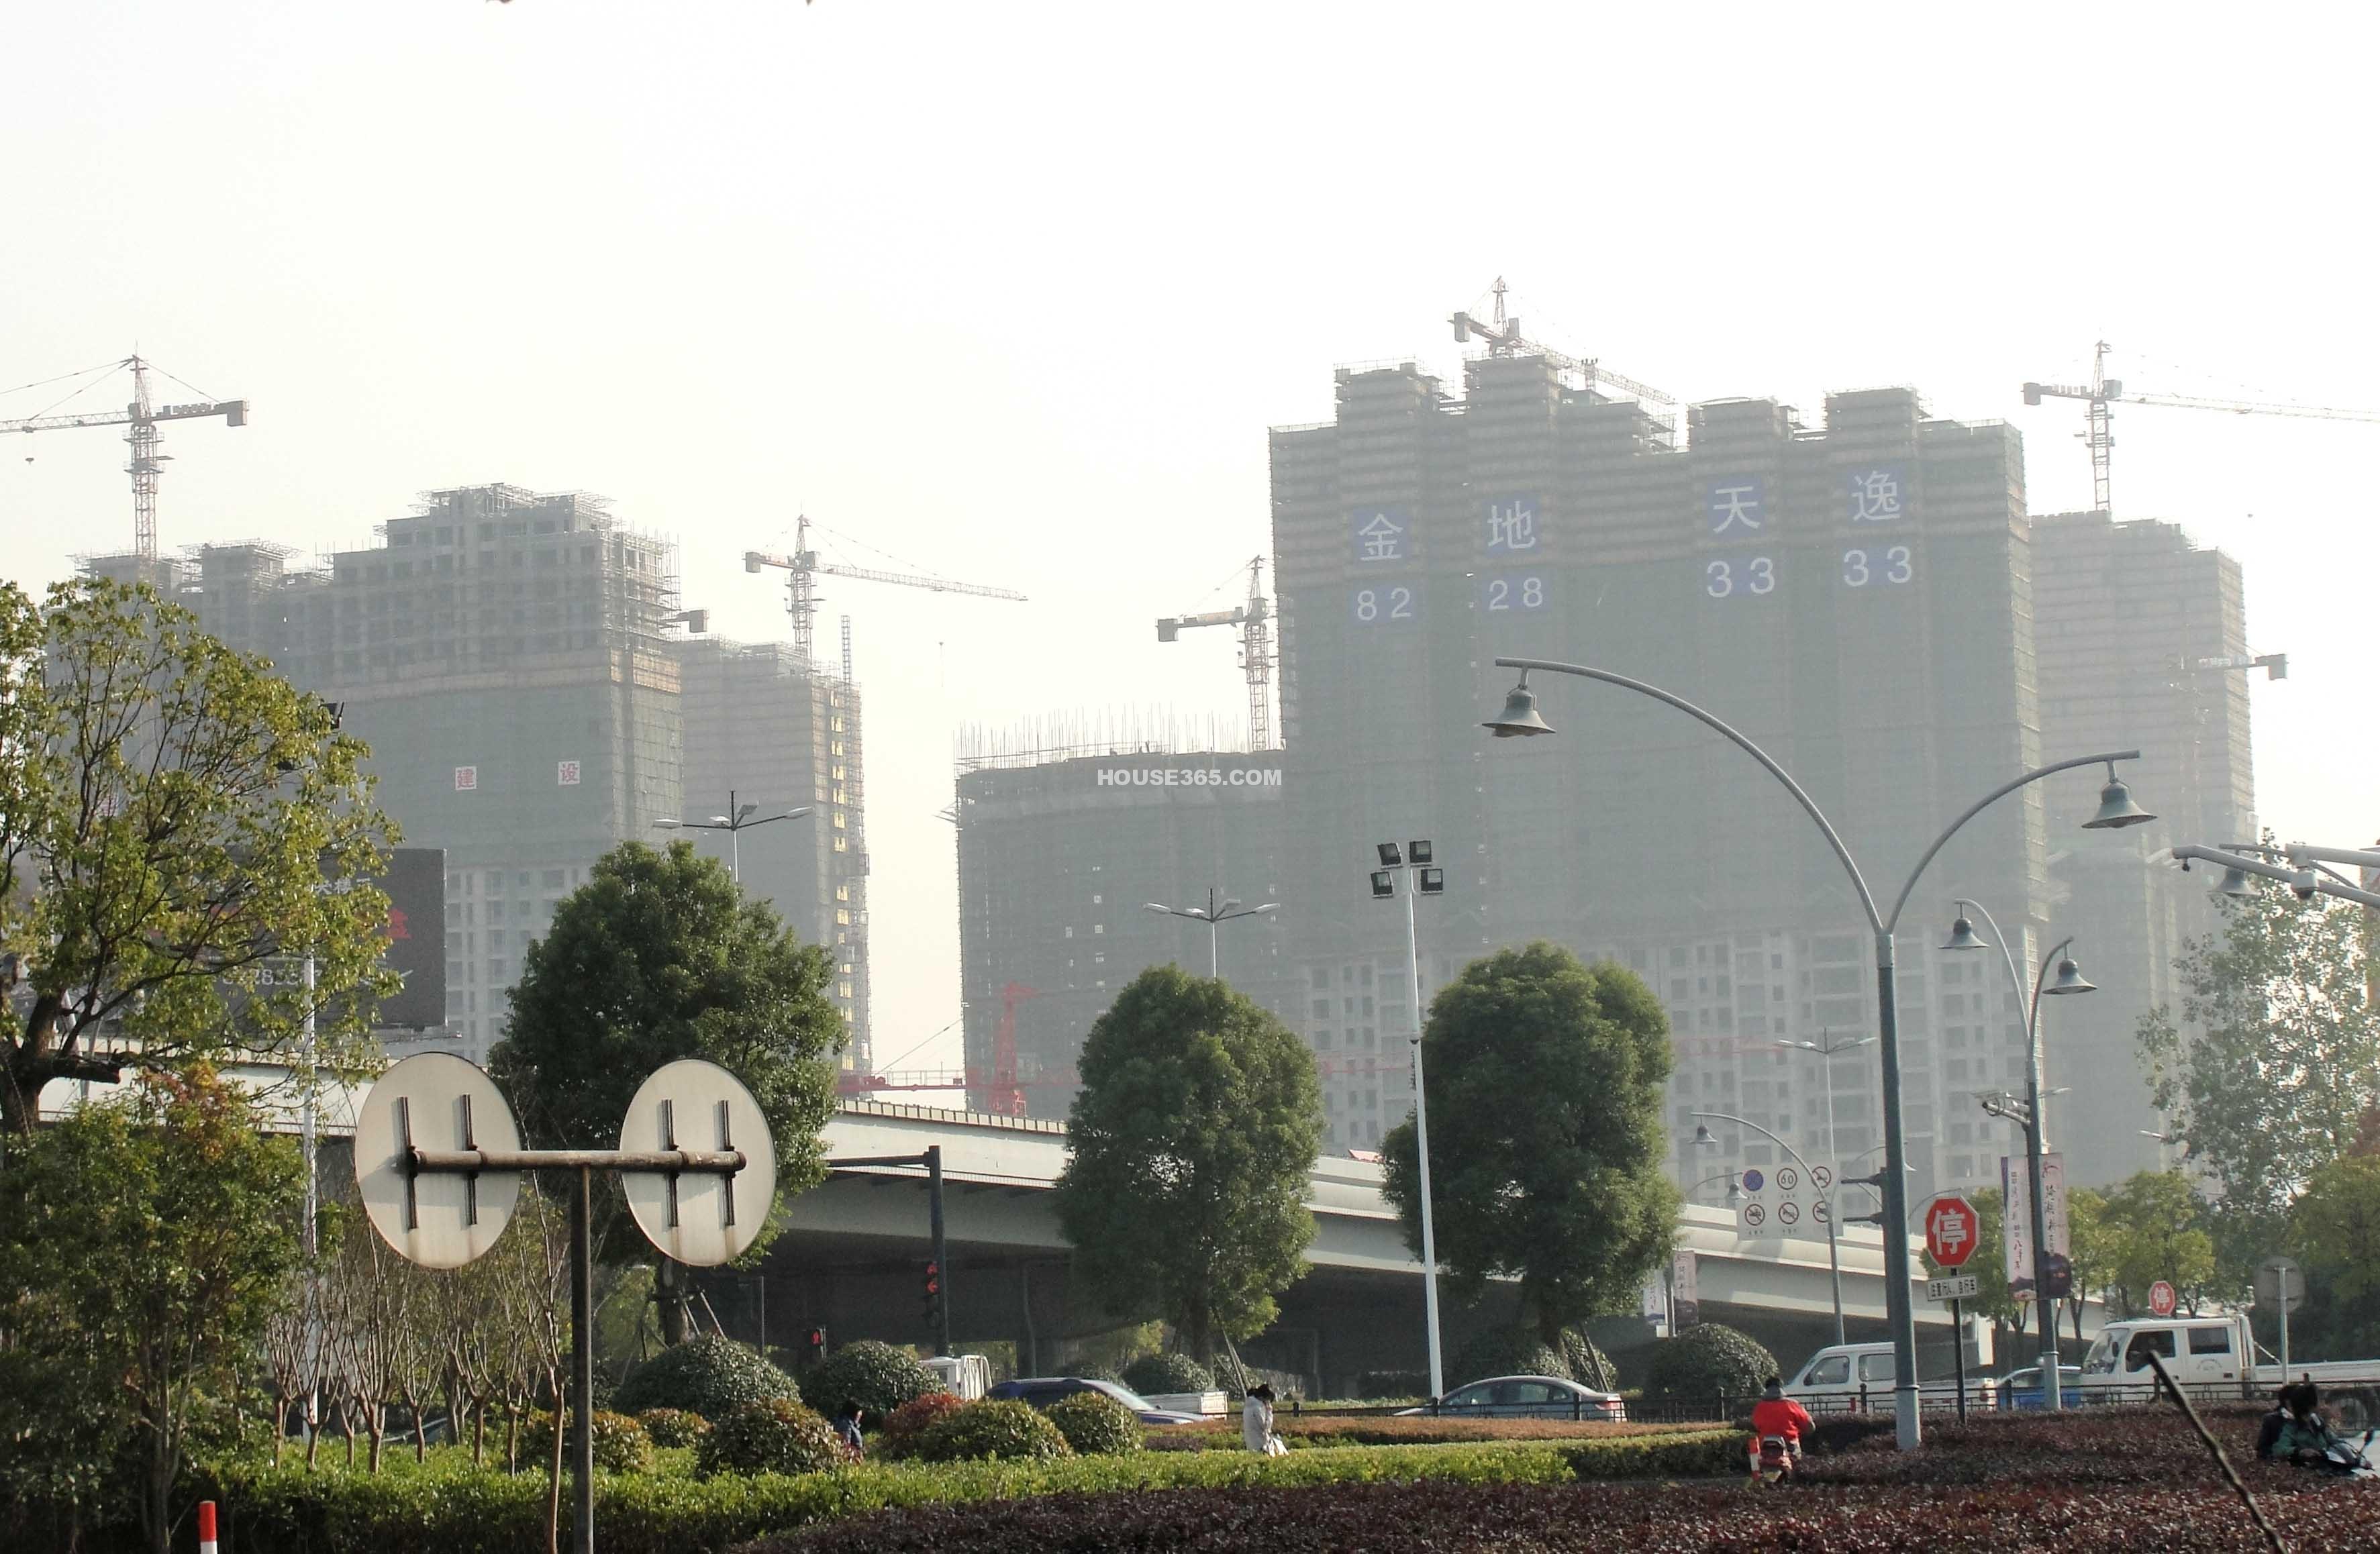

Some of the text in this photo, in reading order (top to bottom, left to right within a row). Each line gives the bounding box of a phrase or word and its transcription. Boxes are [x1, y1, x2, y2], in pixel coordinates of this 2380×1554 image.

[1358, 470, 1901, 561] 金 地 天 逸
[1357, 546, 1912, 621] 82 28 33 33
[1781, 1174, 1794, 1184] 60
[1932, 1208, 1967, 1255] 停
[2153, 1287, 2170, 1309] 停
